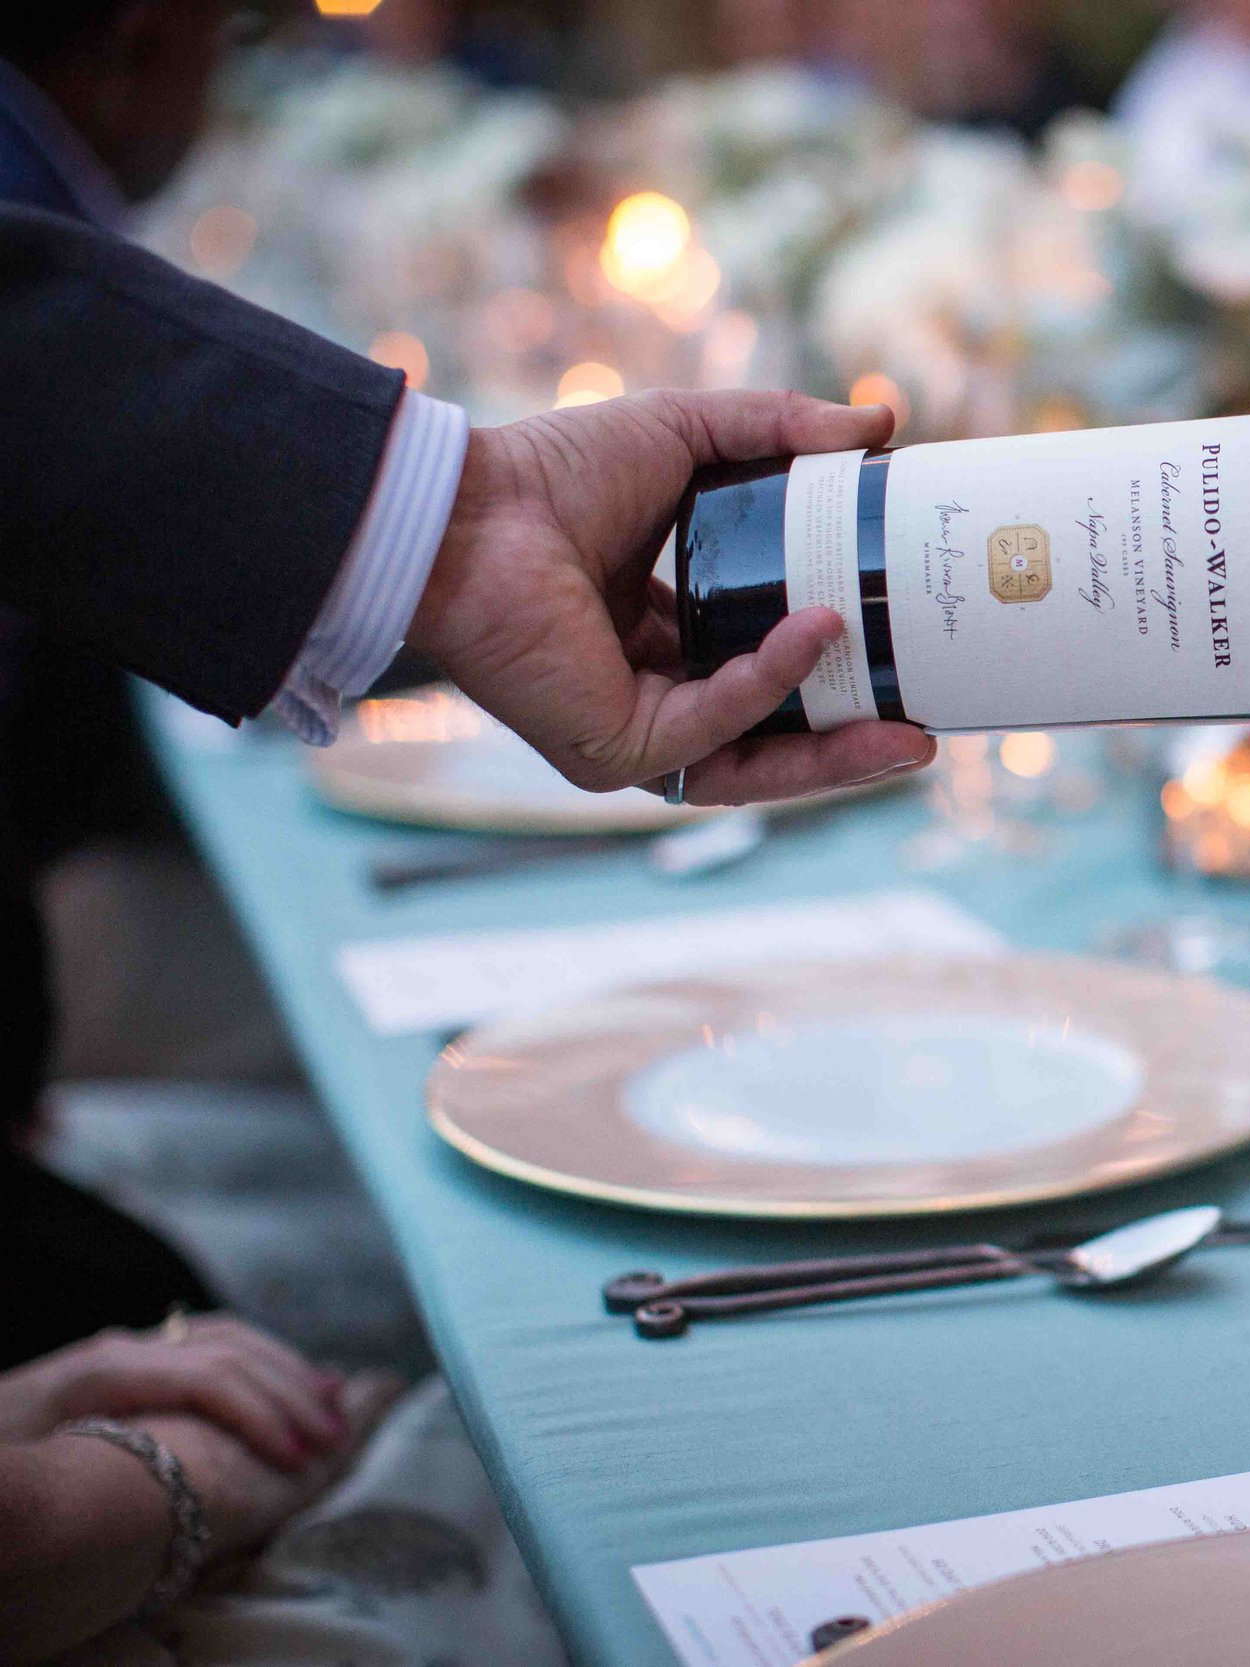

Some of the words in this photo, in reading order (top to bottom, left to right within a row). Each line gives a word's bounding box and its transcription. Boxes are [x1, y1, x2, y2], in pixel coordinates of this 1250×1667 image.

[1075, 497, 1107, 549] Napa
[1130, 479, 1143, 553] MELANSON
[1159, 461, 1182, 535] Cabernet
[923, 542, 933, 595] WINEMAKER
[1078, 551, 1115, 614] Valley
[1202, 443, 1231, 669] PULIDO-WALKER
[1133, 559, 1149, 635] VINEYARD
[1150, 536, 1184, 652] Sauvignon
[848, 676, 861, 710] VINEYARD
